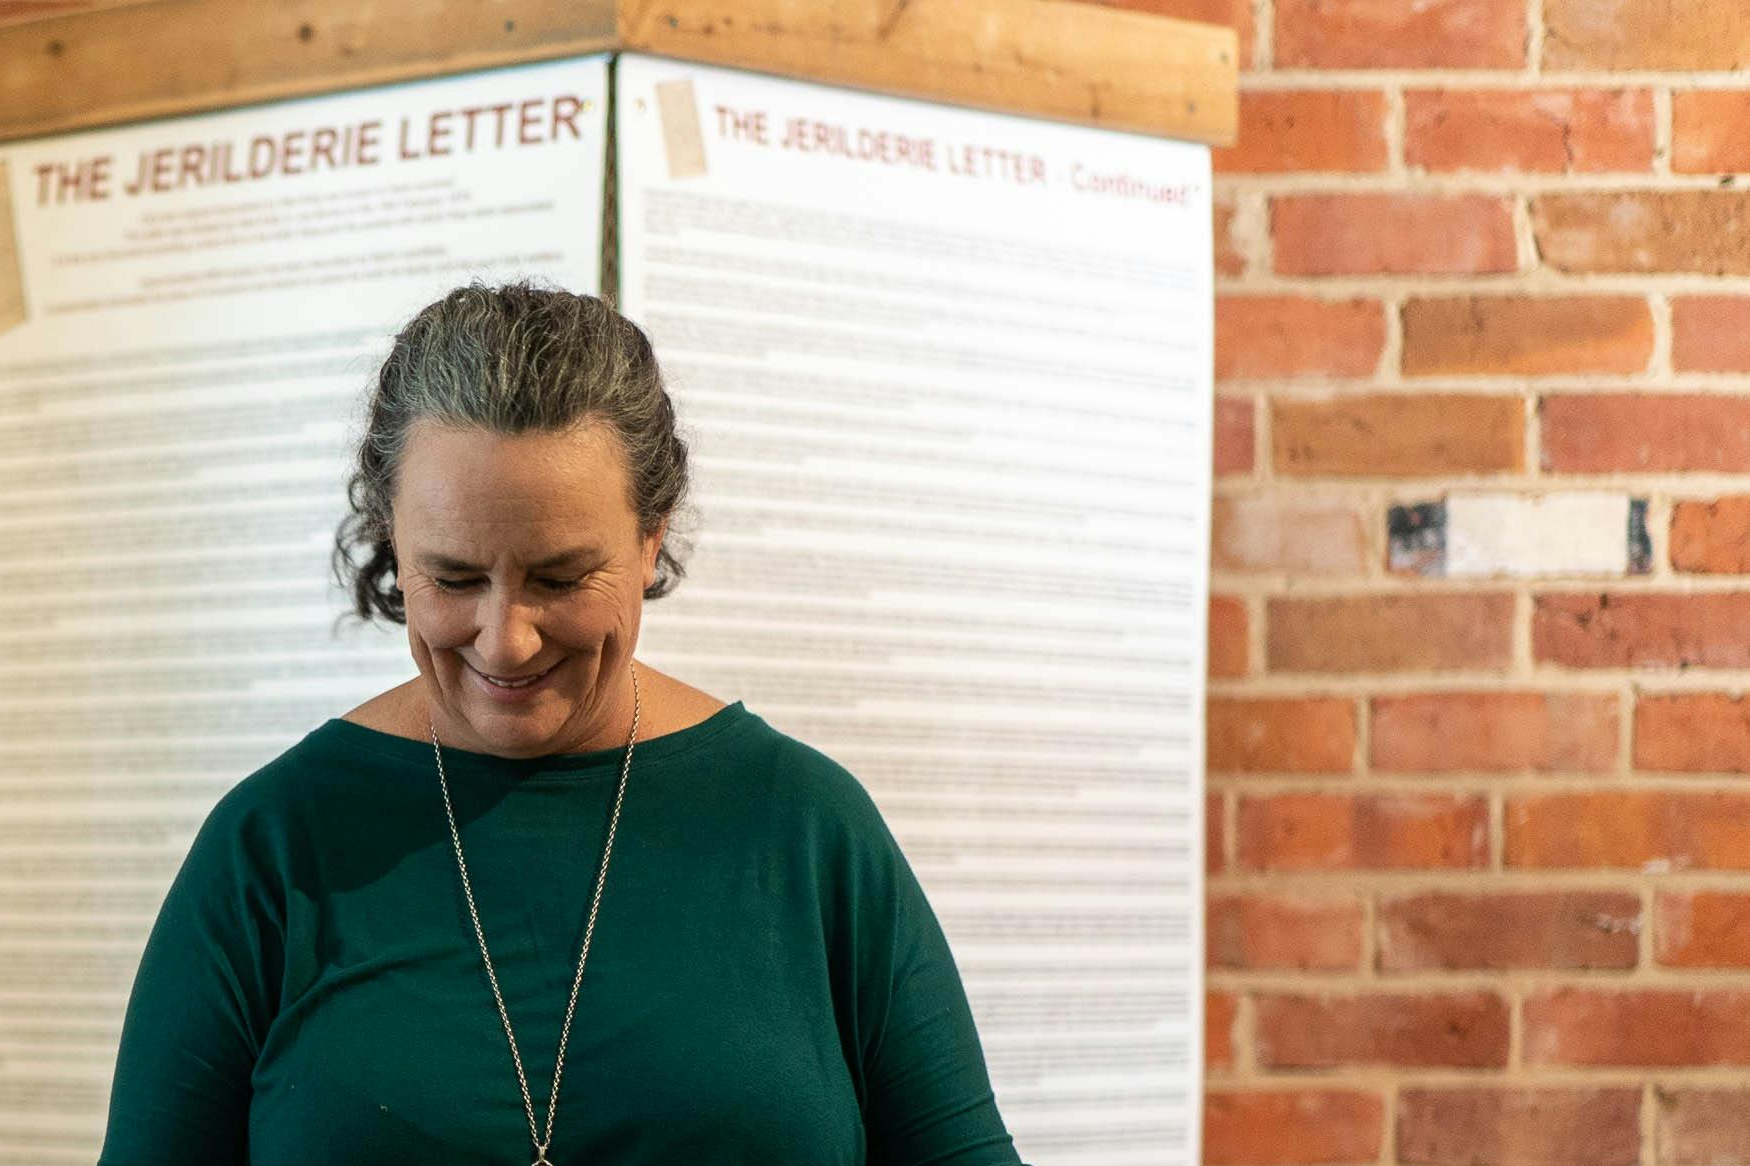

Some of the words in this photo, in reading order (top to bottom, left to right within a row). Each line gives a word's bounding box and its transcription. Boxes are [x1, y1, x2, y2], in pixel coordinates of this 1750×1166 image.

[32, 156, 112, 209] THE
[123, 119, 381, 198] JERILDERIE
[398, 94, 584, 163] LETTER
[716, 105, 769, 148] THE
[780, 115, 938, 173] JERILDERIE
[948, 142, 1048, 186] LETTER
[1070, 162, 1189, 208] Continued
